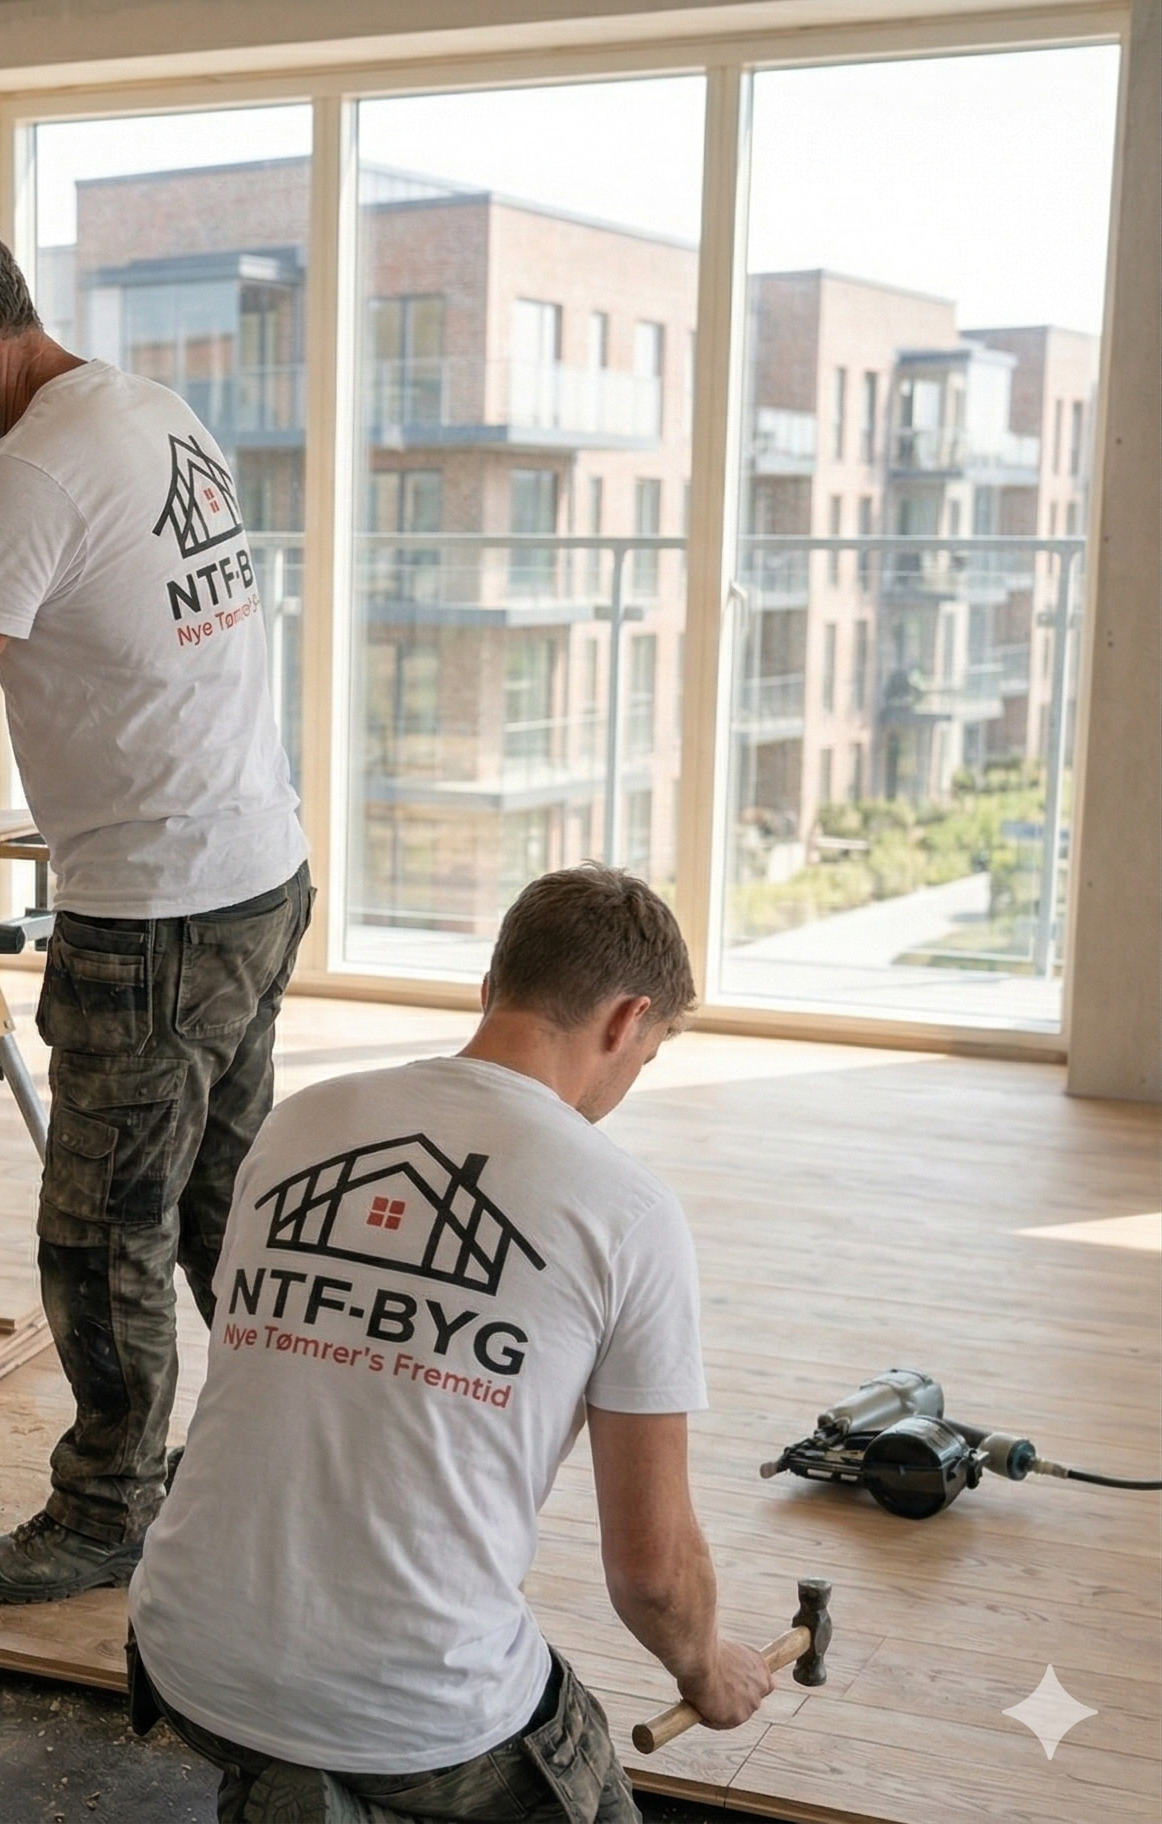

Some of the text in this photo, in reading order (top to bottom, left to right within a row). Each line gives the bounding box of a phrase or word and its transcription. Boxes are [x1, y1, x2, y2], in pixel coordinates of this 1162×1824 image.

[177, 621, 213, 646] Nye
[228, 1268, 528, 1375] NTF-BYG
[223, 1323, 511, 1408] Nye Tømrer's Fremtid
